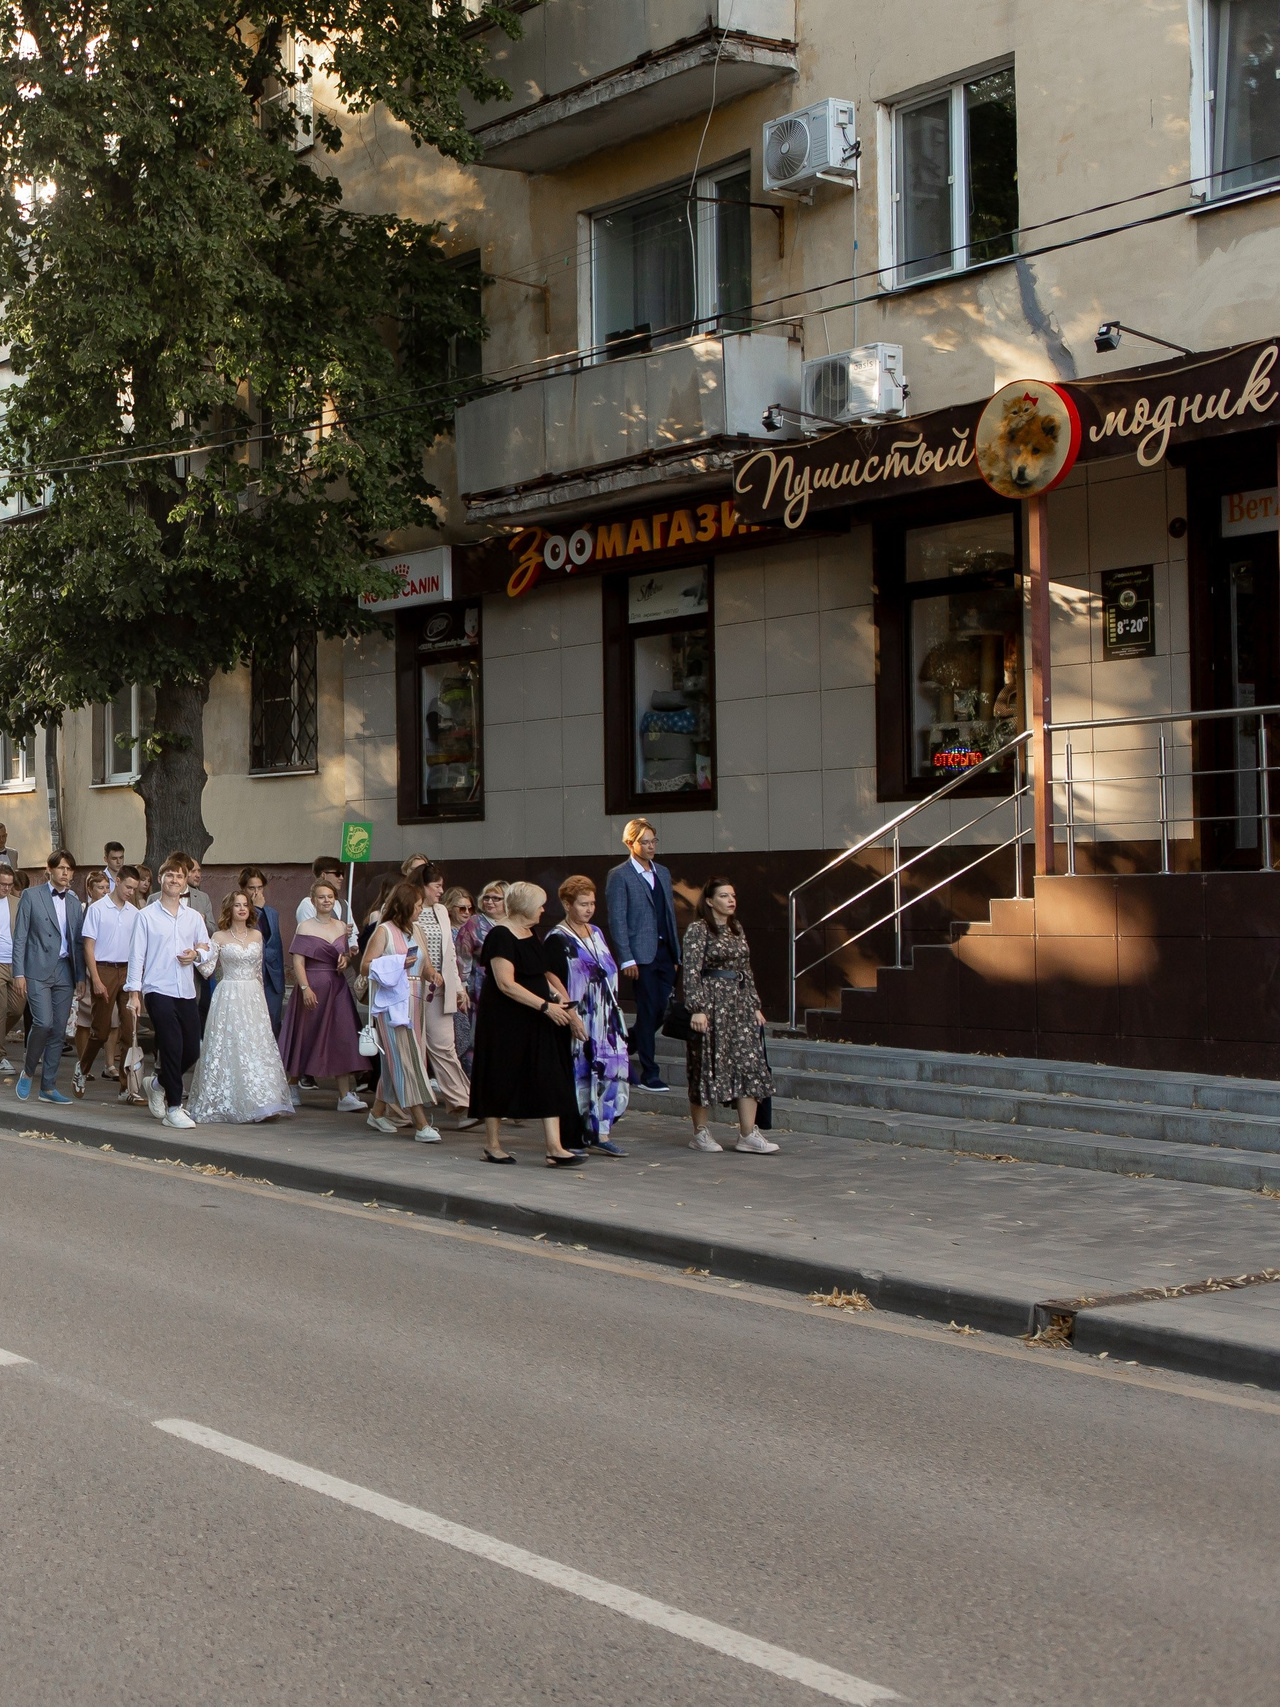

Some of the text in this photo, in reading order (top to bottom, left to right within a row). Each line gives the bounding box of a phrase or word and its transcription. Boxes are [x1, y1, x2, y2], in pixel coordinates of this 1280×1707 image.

[853, 360, 873, 371] oasis
[735, 345, 1279, 529] Пушистый модник
[1227, 493, 1278, 523] Вет
[507, 500, 765, 597] ЗООМАГАЗИ
[934, 752, 983, 767] ОТКРЫТО
